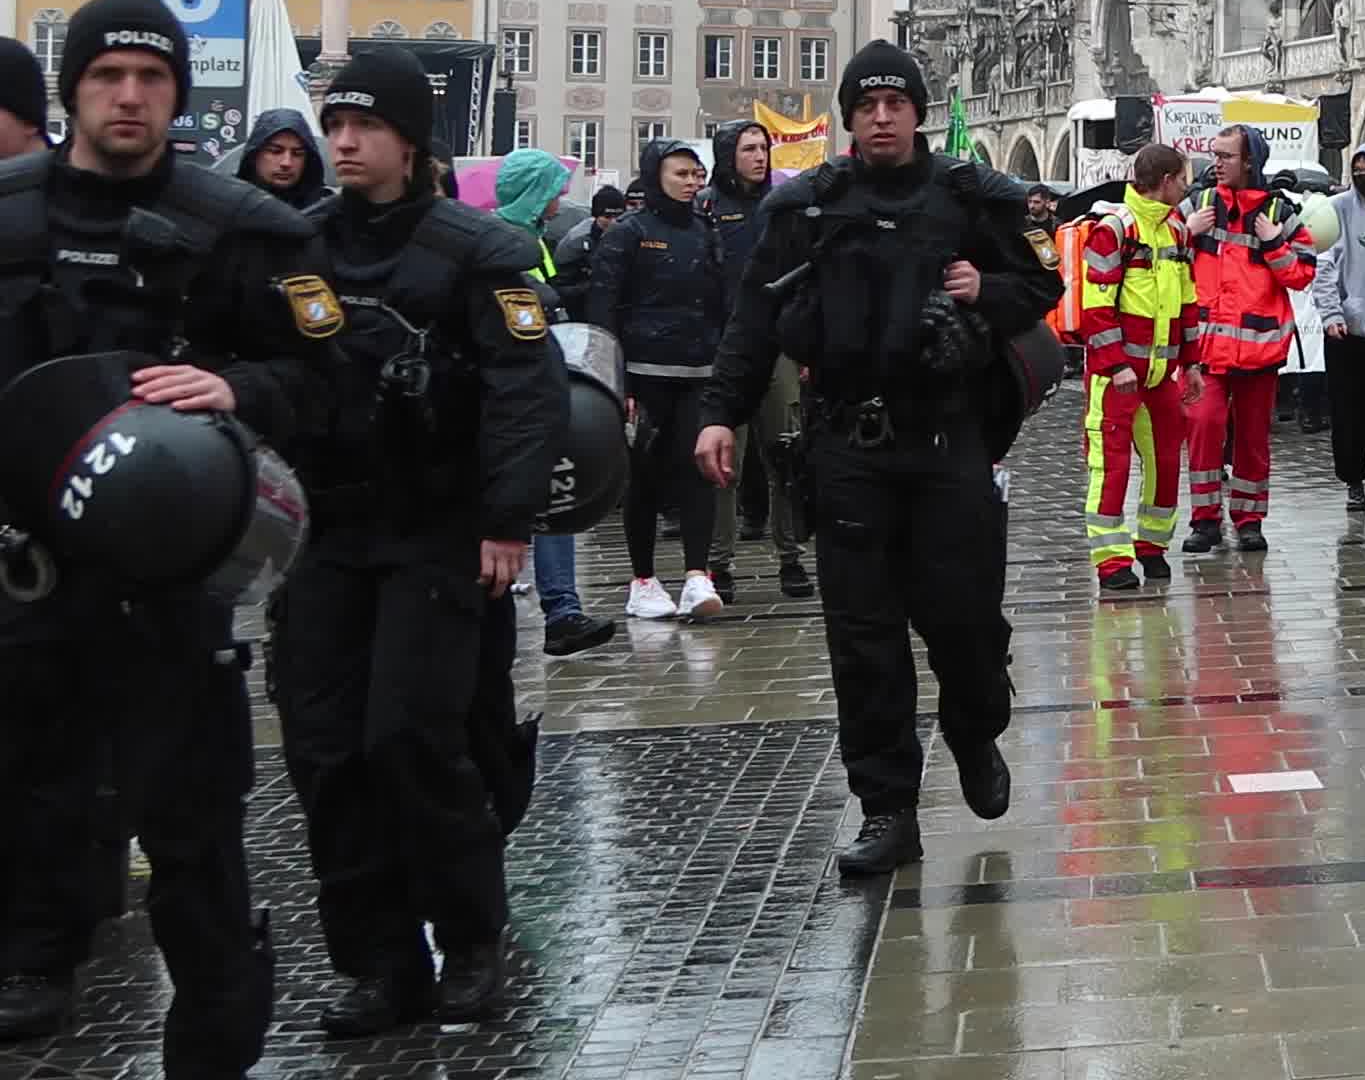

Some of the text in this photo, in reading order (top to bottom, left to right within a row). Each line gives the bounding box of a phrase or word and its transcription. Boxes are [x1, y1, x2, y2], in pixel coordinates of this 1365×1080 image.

[104, 30, 173, 53] POLIZEI
[859, 75, 906, 88] POLIZEI
[1258, 127, 1302, 141] UND
[57, 249, 119, 265] POLIZEI
